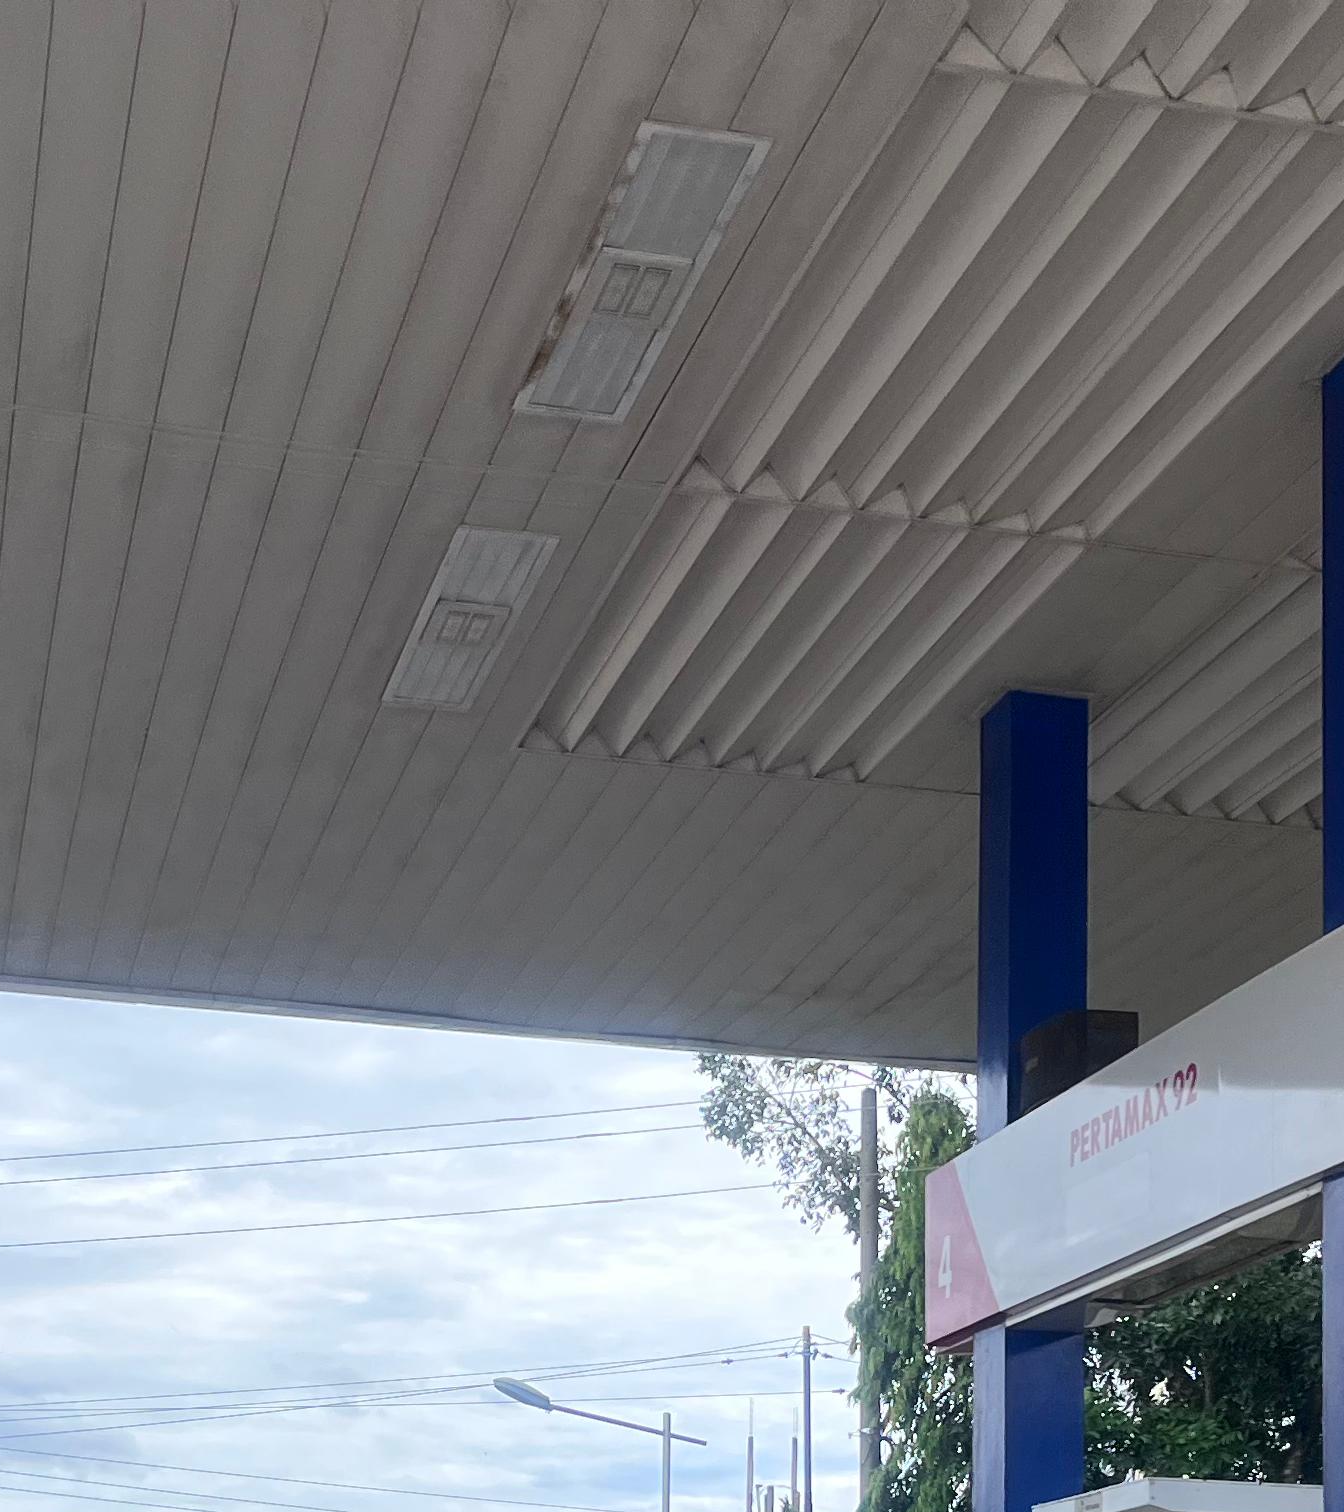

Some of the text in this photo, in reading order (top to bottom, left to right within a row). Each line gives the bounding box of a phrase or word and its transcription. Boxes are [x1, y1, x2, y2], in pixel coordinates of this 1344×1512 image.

[1069, 1062, 1198, 1168] PERTAMAX 92
[937, 1234, 953, 1299] 4
